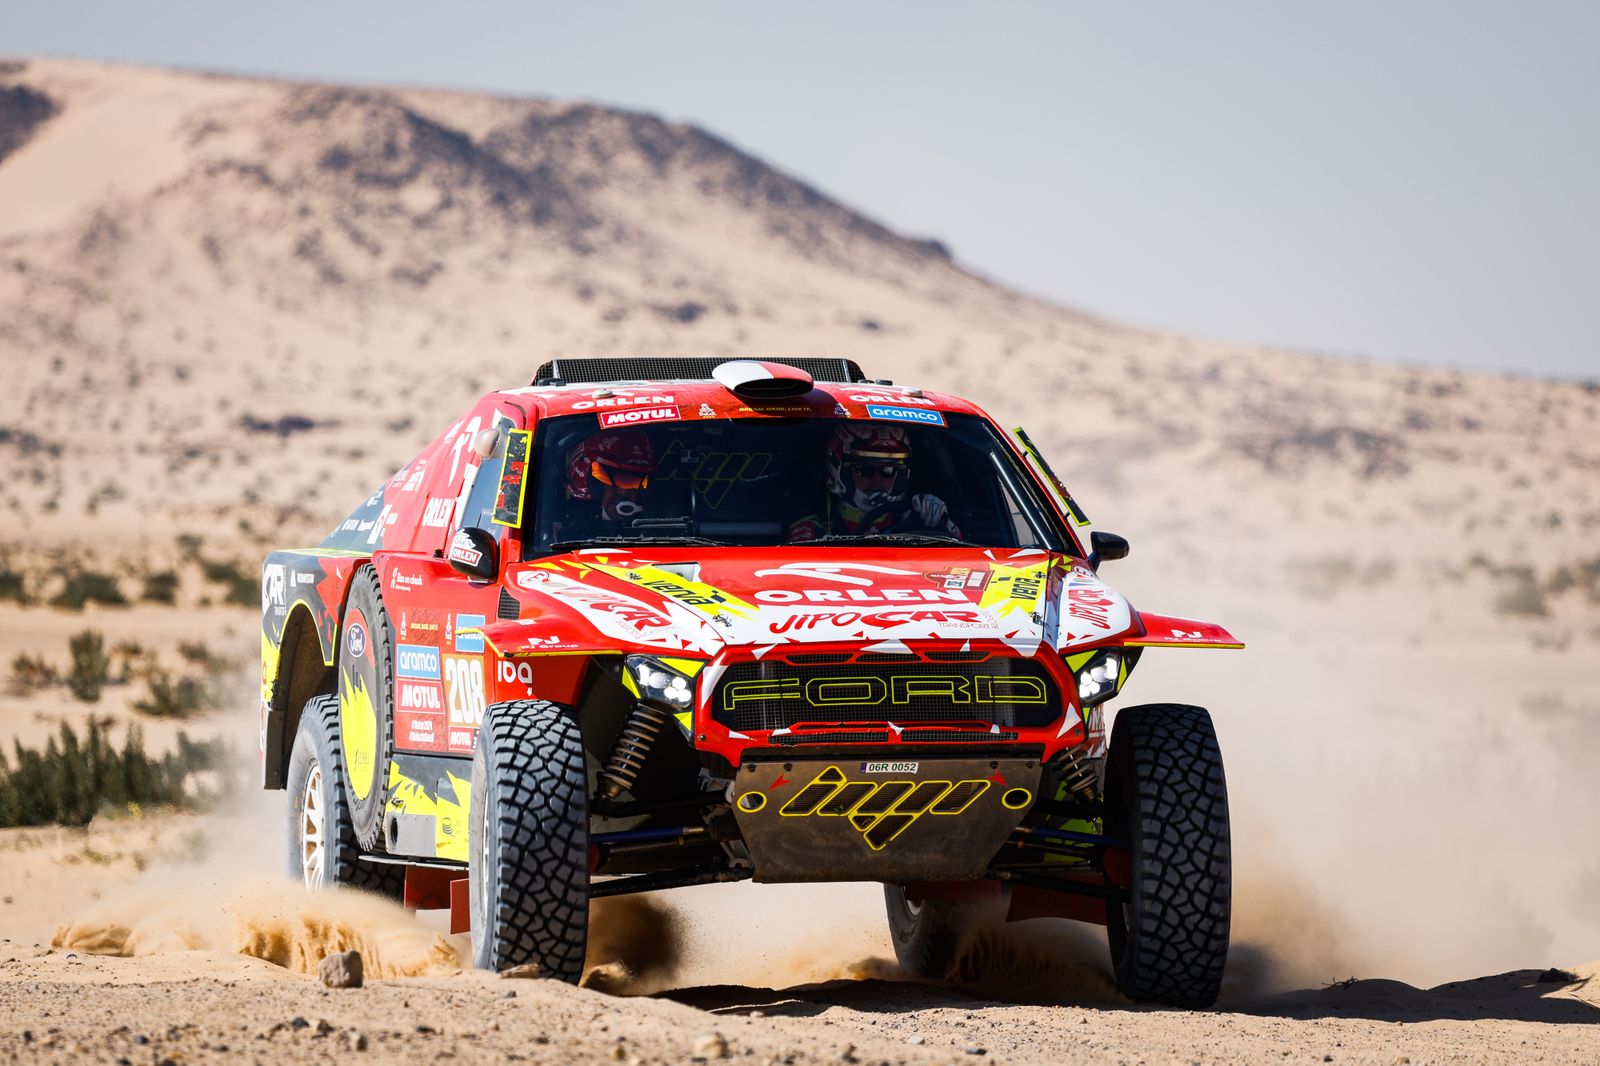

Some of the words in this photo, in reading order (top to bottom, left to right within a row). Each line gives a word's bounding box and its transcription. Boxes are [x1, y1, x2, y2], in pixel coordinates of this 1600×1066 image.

[571, 395, 675, 410] ORLEN
[849, 395, 936, 406] ORLEN
[607, 408, 677, 425] MOTUL
[872, 408, 939, 421] aramco
[422, 497, 455, 527] ORLEN
[453, 547, 478, 563] ORLEN
[754, 589, 970, 603] ORLEN
[400, 651, 438, 673] aramco
[401, 684, 441, 709] MOTUL
[445, 657, 486, 726] 208
[723, 675, 1047, 710] FORD
[450, 731, 472, 747] MOTUL
[868, 763, 889, 772] 06R
[891, 763, 916, 772] 0052
